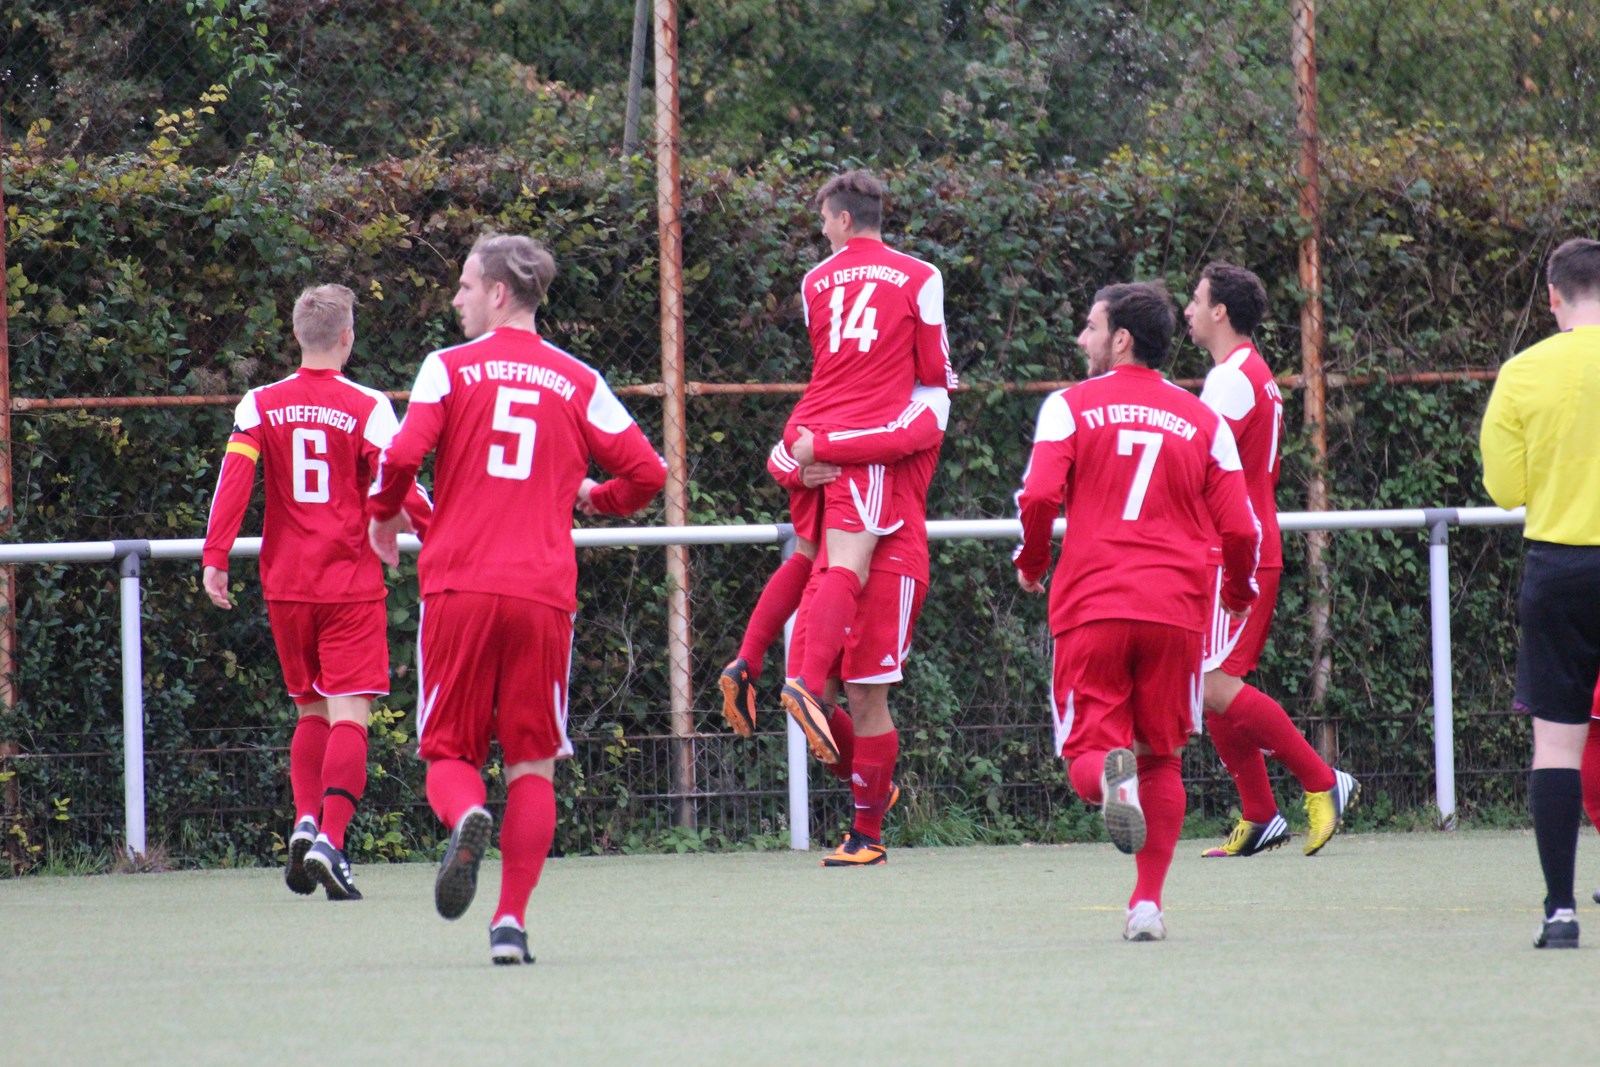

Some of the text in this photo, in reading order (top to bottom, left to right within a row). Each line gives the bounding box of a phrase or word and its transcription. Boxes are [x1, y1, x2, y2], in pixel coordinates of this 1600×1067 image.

[813, 264, 910, 294] TV OEFFINGEN
[829, 282, 879, 353] 14
[458, 359, 577, 402] TV OEFFINGEN
[265, 404, 358, 434] TV OEFFINGEN
[486, 385, 541, 481] 5
[1081, 403, 1198, 442] TV OEFFINGEN
[292, 427, 330, 504] 6
[1116, 428, 1164, 521] 7
